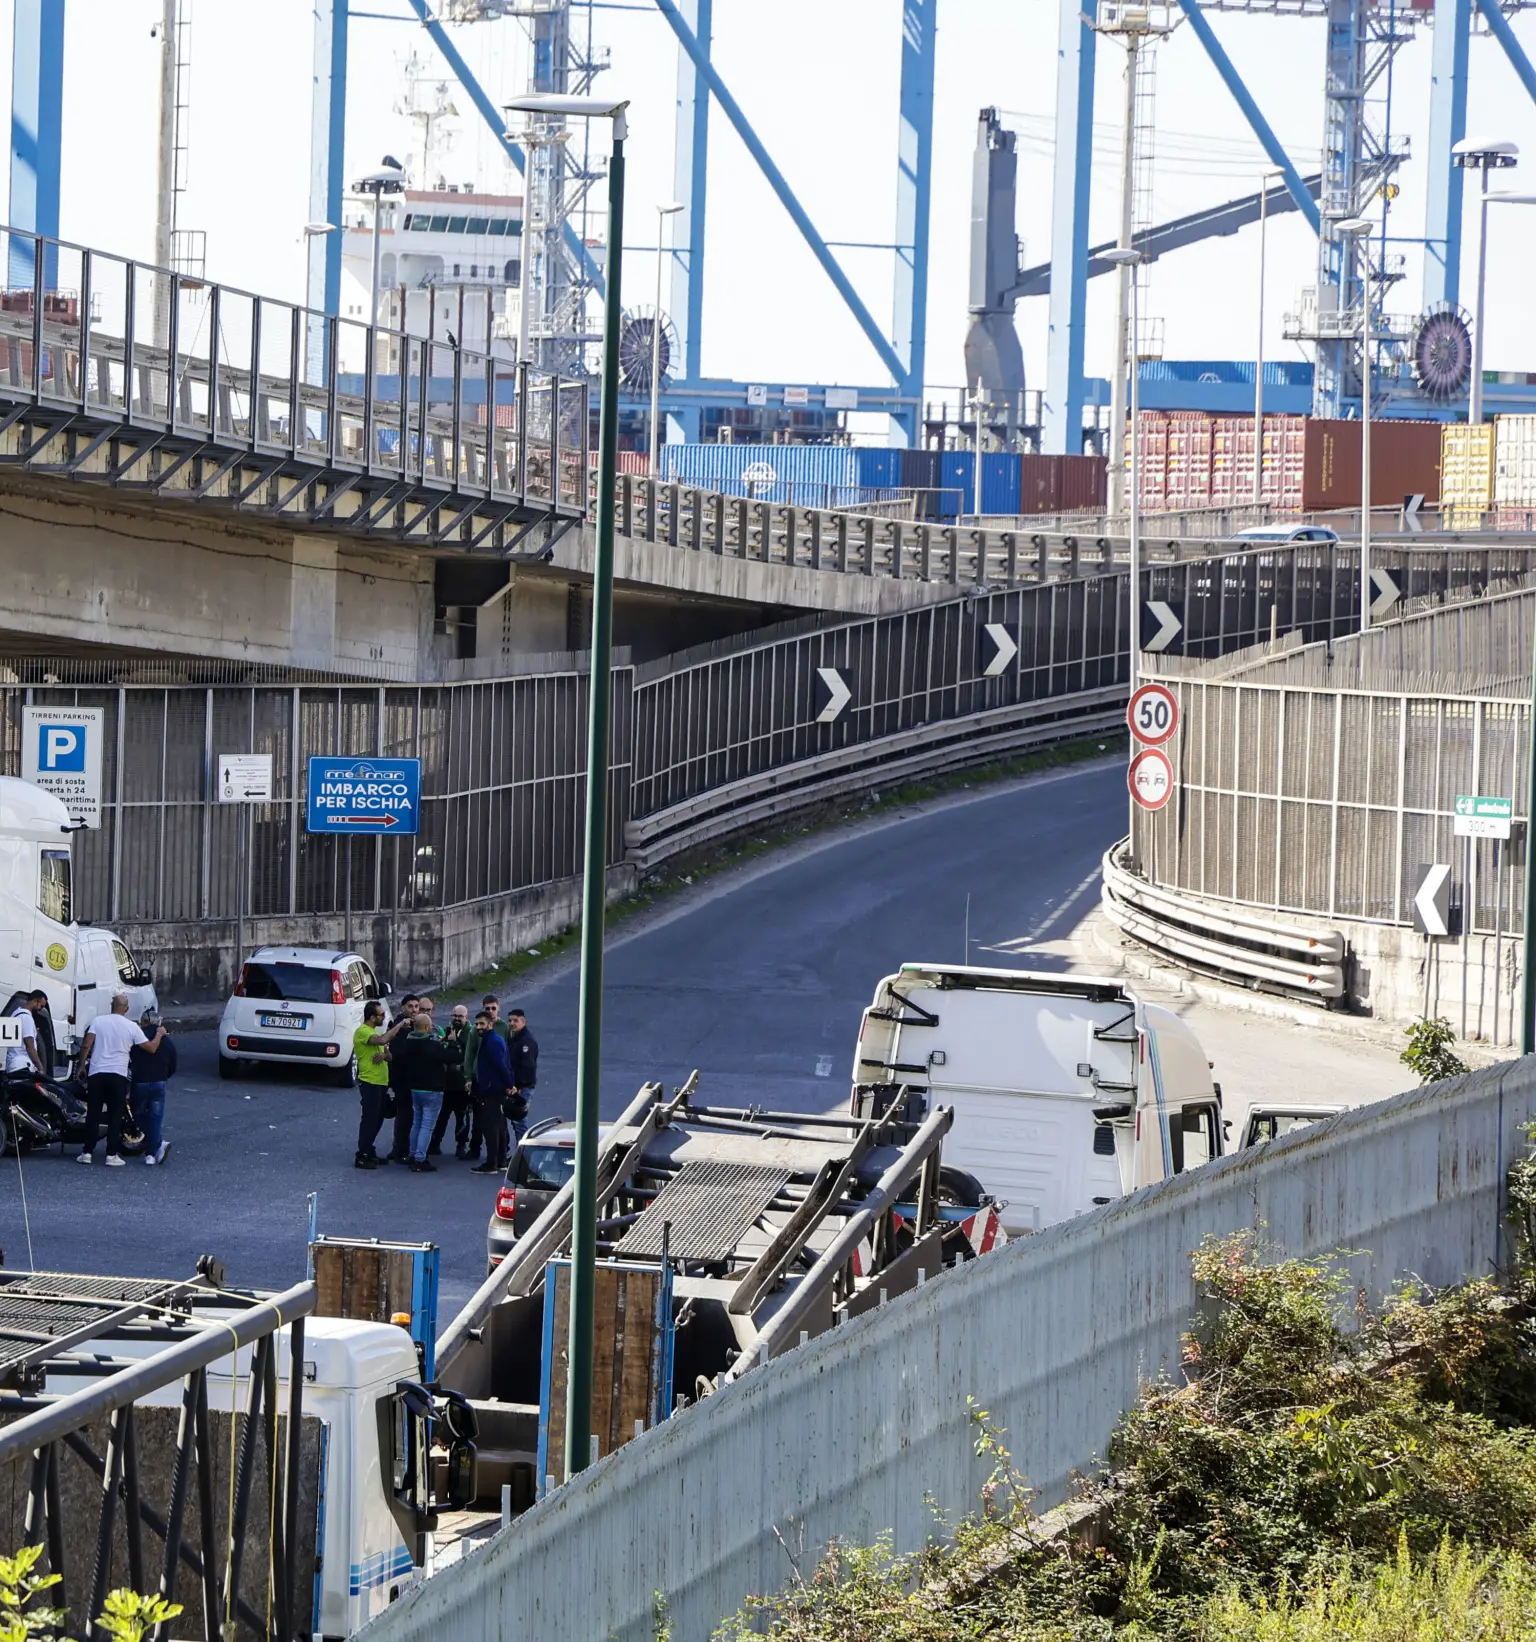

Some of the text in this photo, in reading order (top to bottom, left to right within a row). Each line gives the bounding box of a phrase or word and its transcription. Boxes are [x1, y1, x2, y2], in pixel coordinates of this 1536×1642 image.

[63, 713, 96, 721] PARKING
[1140, 701, 1169, 729] 50
[47, 729, 77, 768] P
[55, 777, 63, 785] di
[321, 783, 408, 796] IMBARCO
[316, 796, 412, 809] PER ISCHIA
[1469, 820, 1485, 832] 300
[49, 949, 66, 964] CTS
